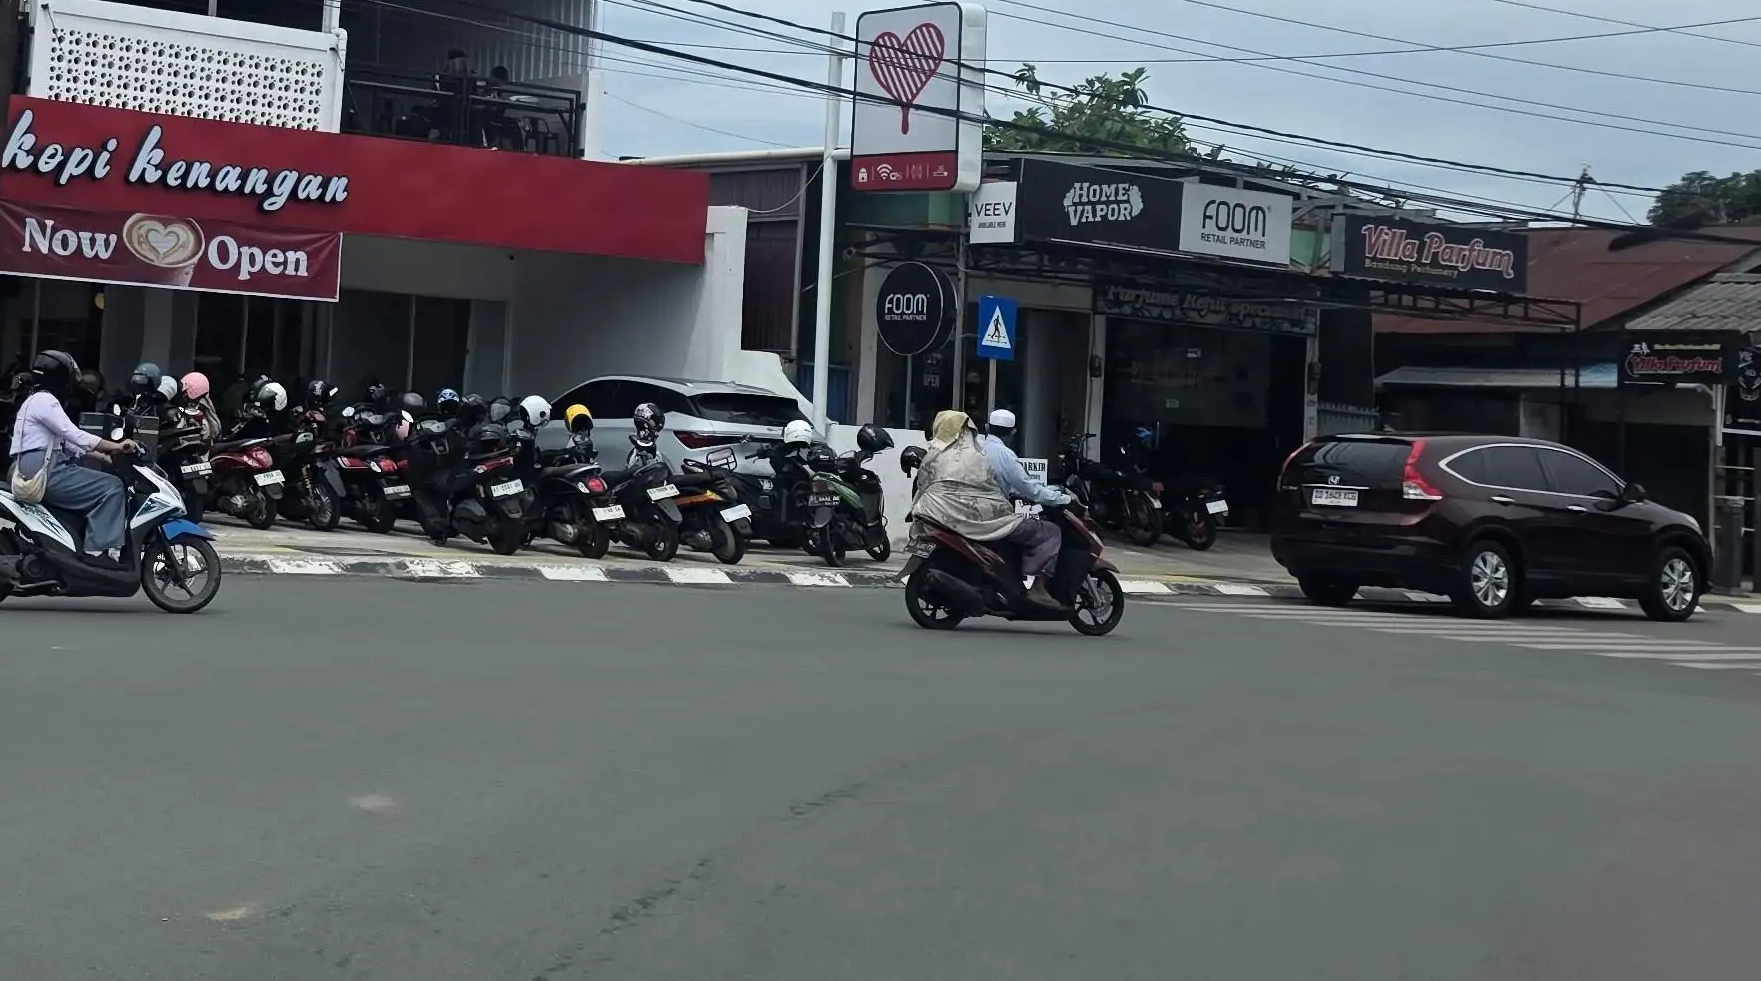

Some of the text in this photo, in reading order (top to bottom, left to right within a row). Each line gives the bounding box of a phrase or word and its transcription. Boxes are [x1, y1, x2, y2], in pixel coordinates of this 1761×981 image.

[1, 109, 350, 212] kopi kenangan
[1073, 182, 1131, 203] HOME
[975, 201, 1013, 218] VEEV
[1068, 204, 1132, 226] VAPOR
[22, 217, 309, 281] Now Open
[1200, 232, 1267, 250] RETAIL PARTNER
[1361, 224, 1515, 279] Villa Parfum
